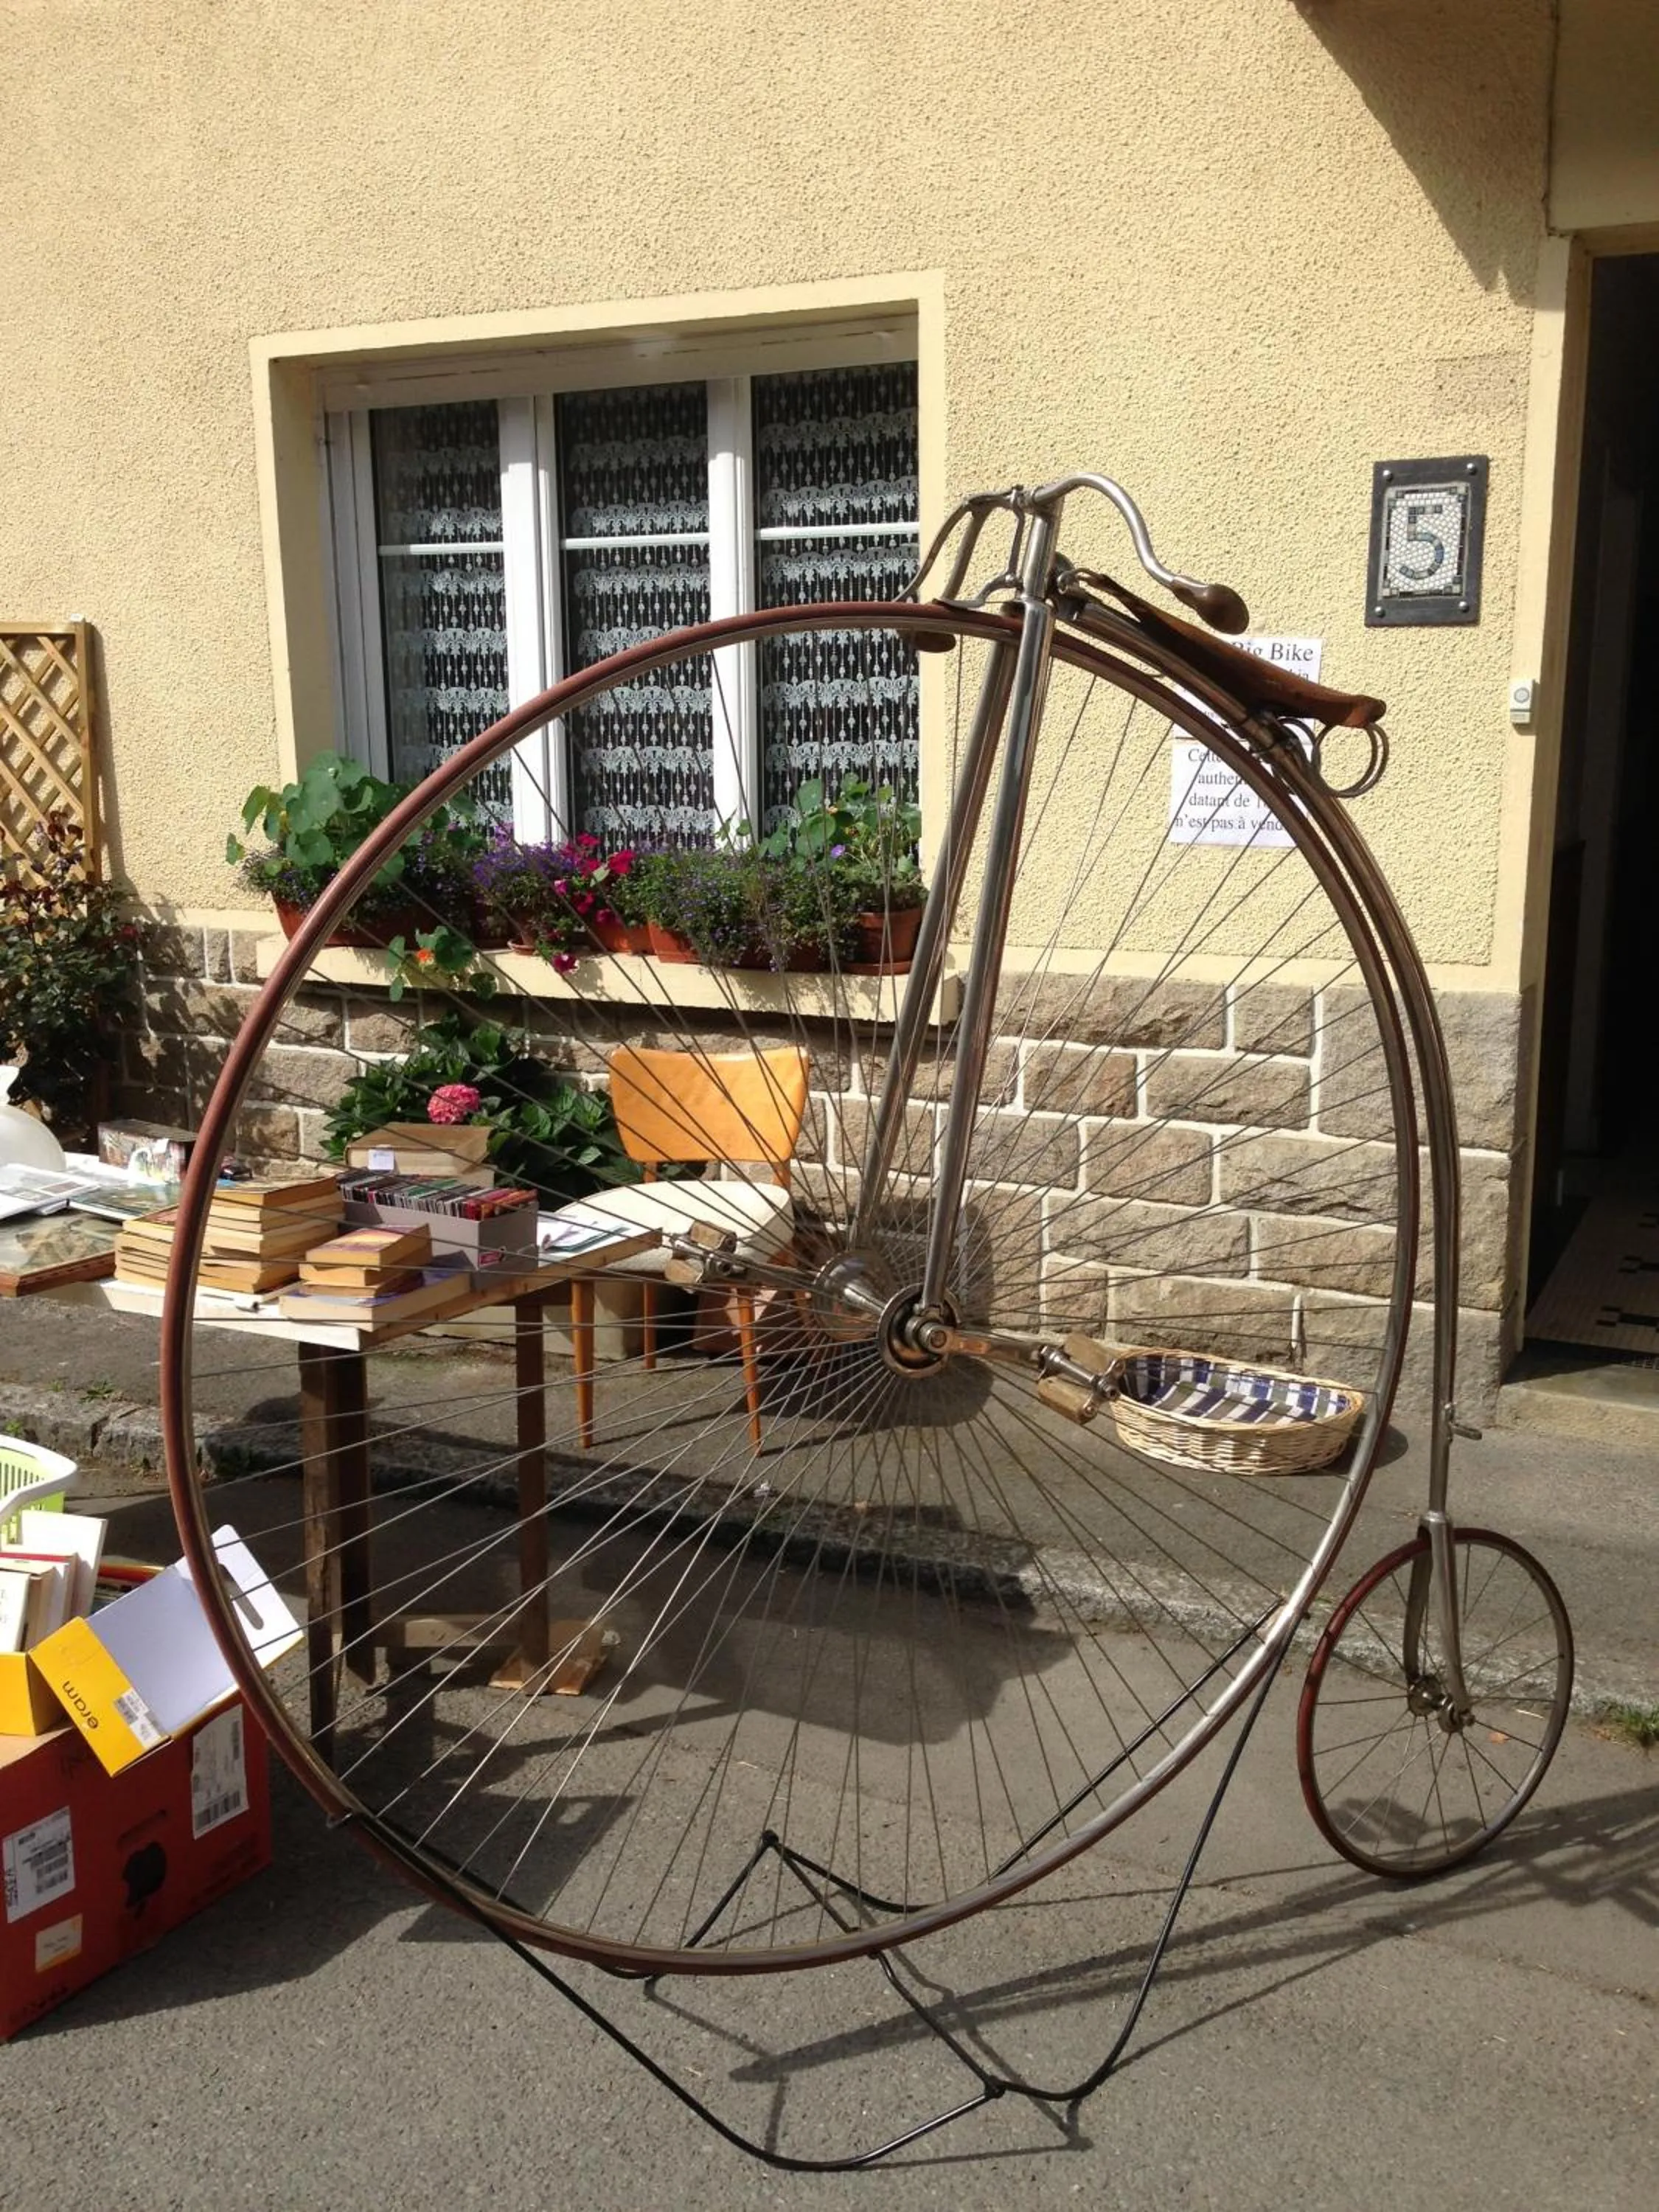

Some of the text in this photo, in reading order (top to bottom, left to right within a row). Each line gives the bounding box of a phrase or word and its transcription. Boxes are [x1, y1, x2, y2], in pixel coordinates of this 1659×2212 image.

[1399, 506, 1445, 580] 5
[1270, 642, 1313, 661] Bike
[1189, 793, 1230, 807] datant
[1234, 793, 1250, 807] de
[1175, 814, 1206, 828] n'est
[1211, 818, 1234, 832] pas
[1238, 816, 1245, 830] à
[62, 1680, 99, 1729] eram
